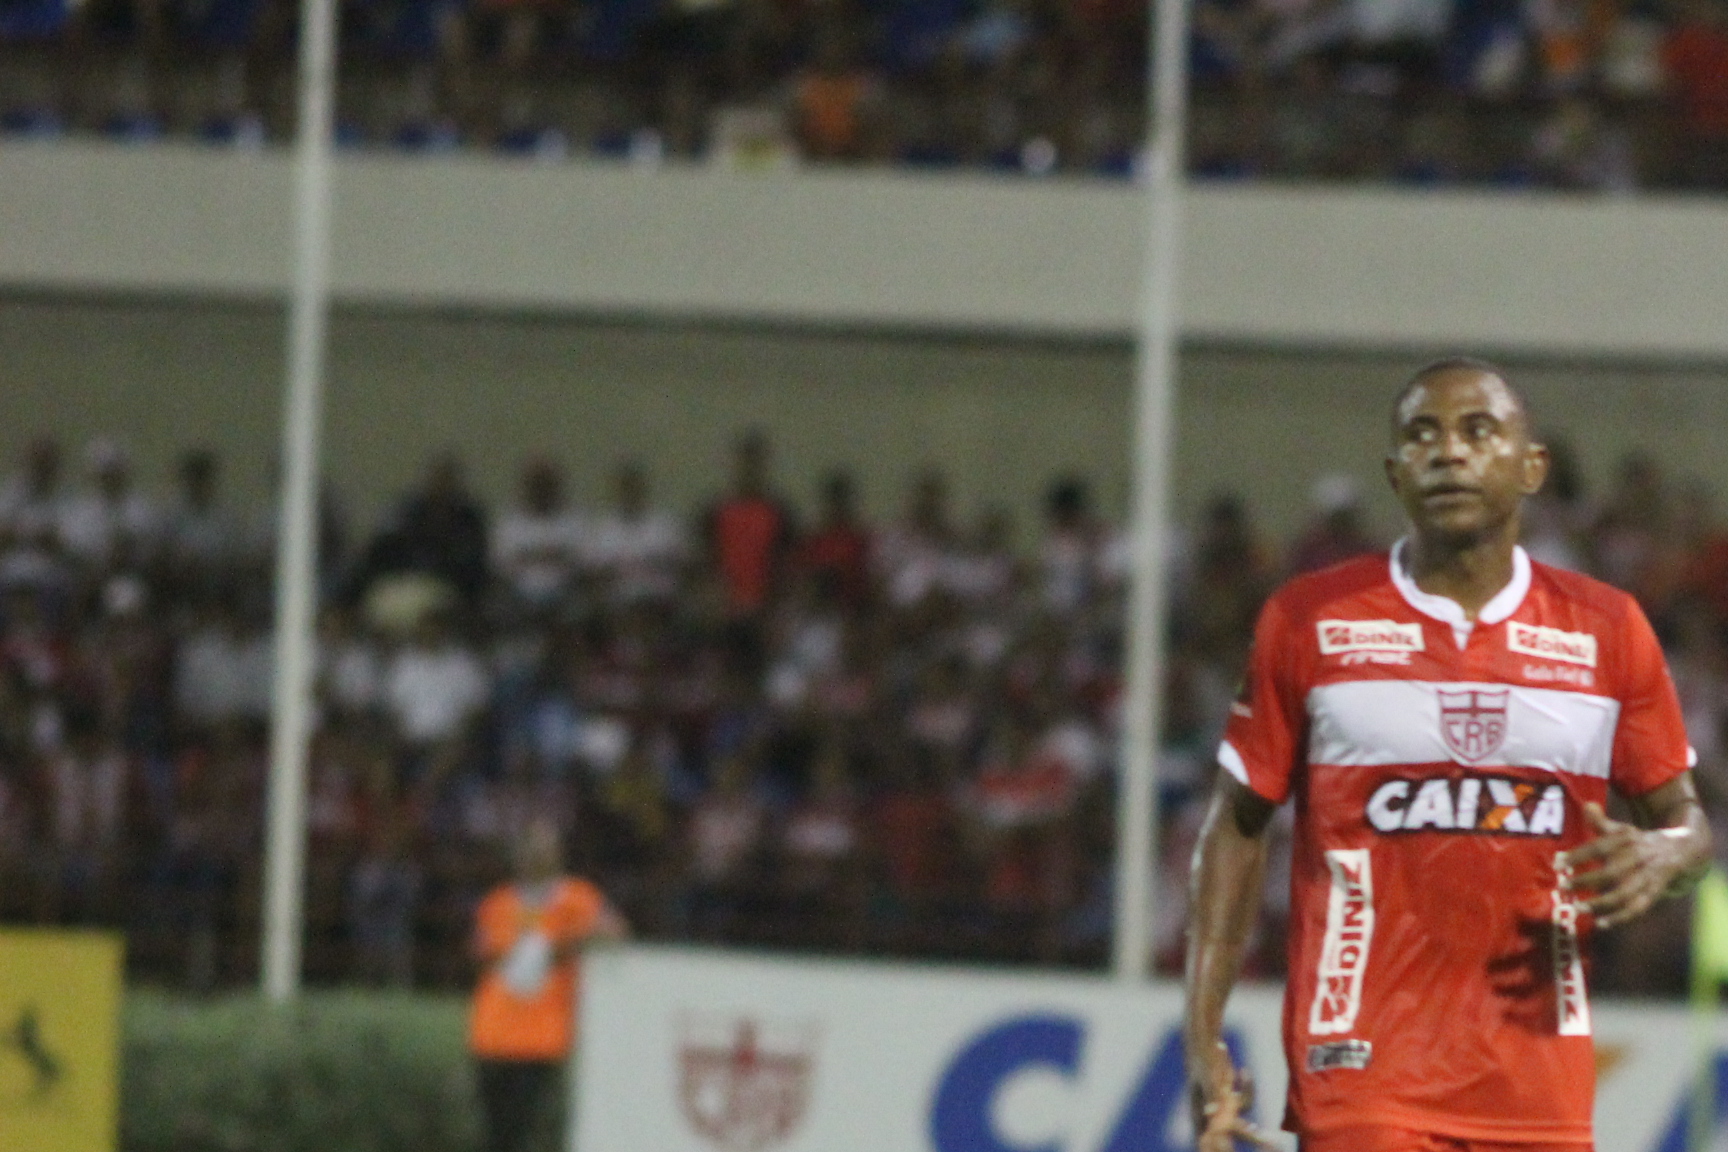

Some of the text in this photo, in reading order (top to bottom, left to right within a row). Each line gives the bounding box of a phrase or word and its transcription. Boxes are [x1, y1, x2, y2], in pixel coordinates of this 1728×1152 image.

[1445, 719, 1504, 753] CRB
[1366, 778, 1565, 835] CAIXA
[1338, 860, 1366, 970] DINIZ
